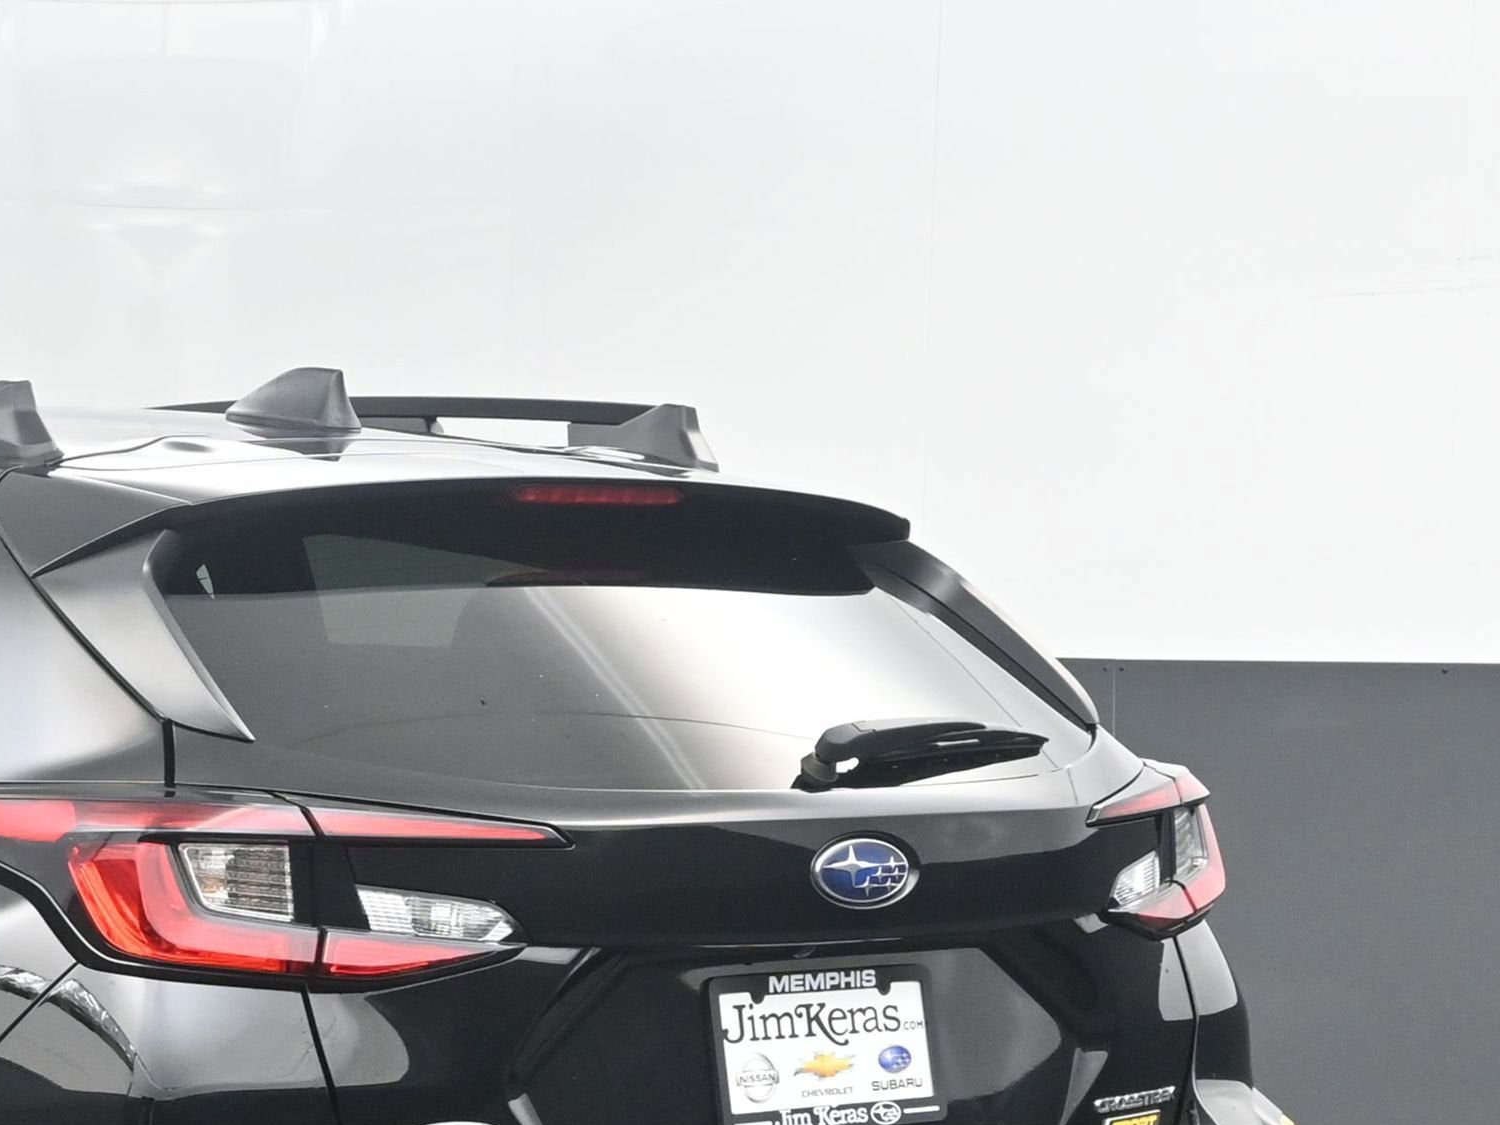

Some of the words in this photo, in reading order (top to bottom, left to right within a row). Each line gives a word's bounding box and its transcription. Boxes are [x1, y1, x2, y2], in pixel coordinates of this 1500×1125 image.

[769, 970, 876, 993] MEMPHIS
[739, 1073, 776, 1085] NISSAN
[871, 1077, 923, 1091] SUBARU
[801, 1086, 854, 1098] CHEVROLET
